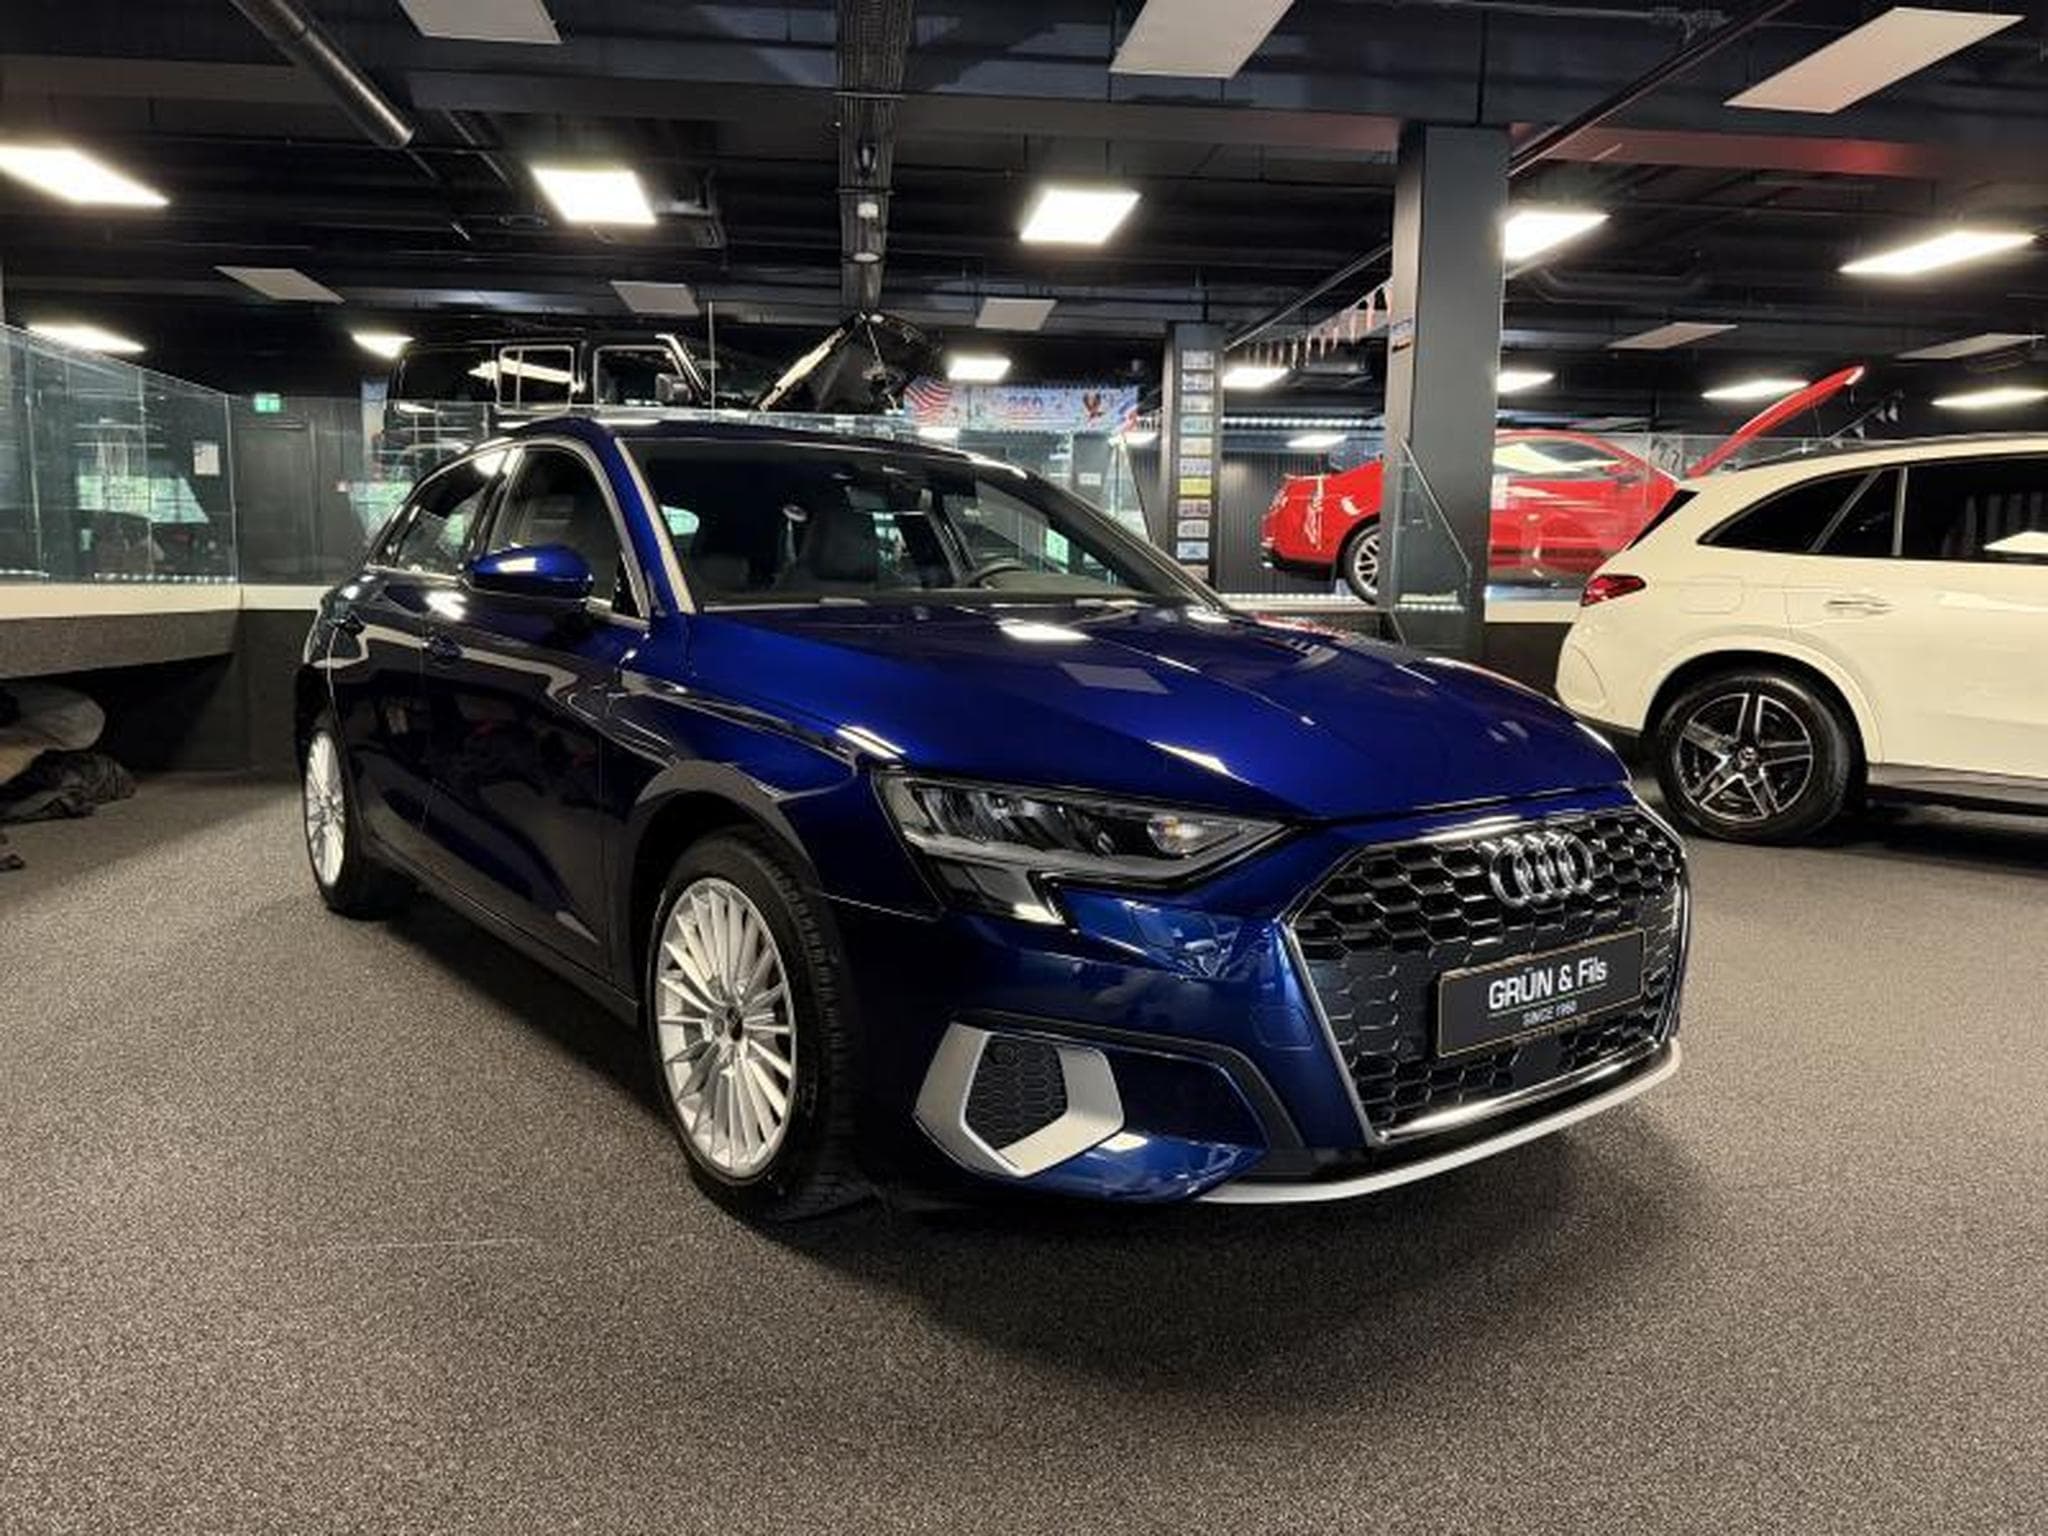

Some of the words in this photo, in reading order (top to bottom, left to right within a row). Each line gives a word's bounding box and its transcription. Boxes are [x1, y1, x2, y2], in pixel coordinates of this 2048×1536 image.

[1489, 966, 1552, 1009] GRÜN
[1558, 964, 1573, 991] &
[1577, 956, 1607, 986] Fils
[1523, 1006, 1554, 1025] SINCE
